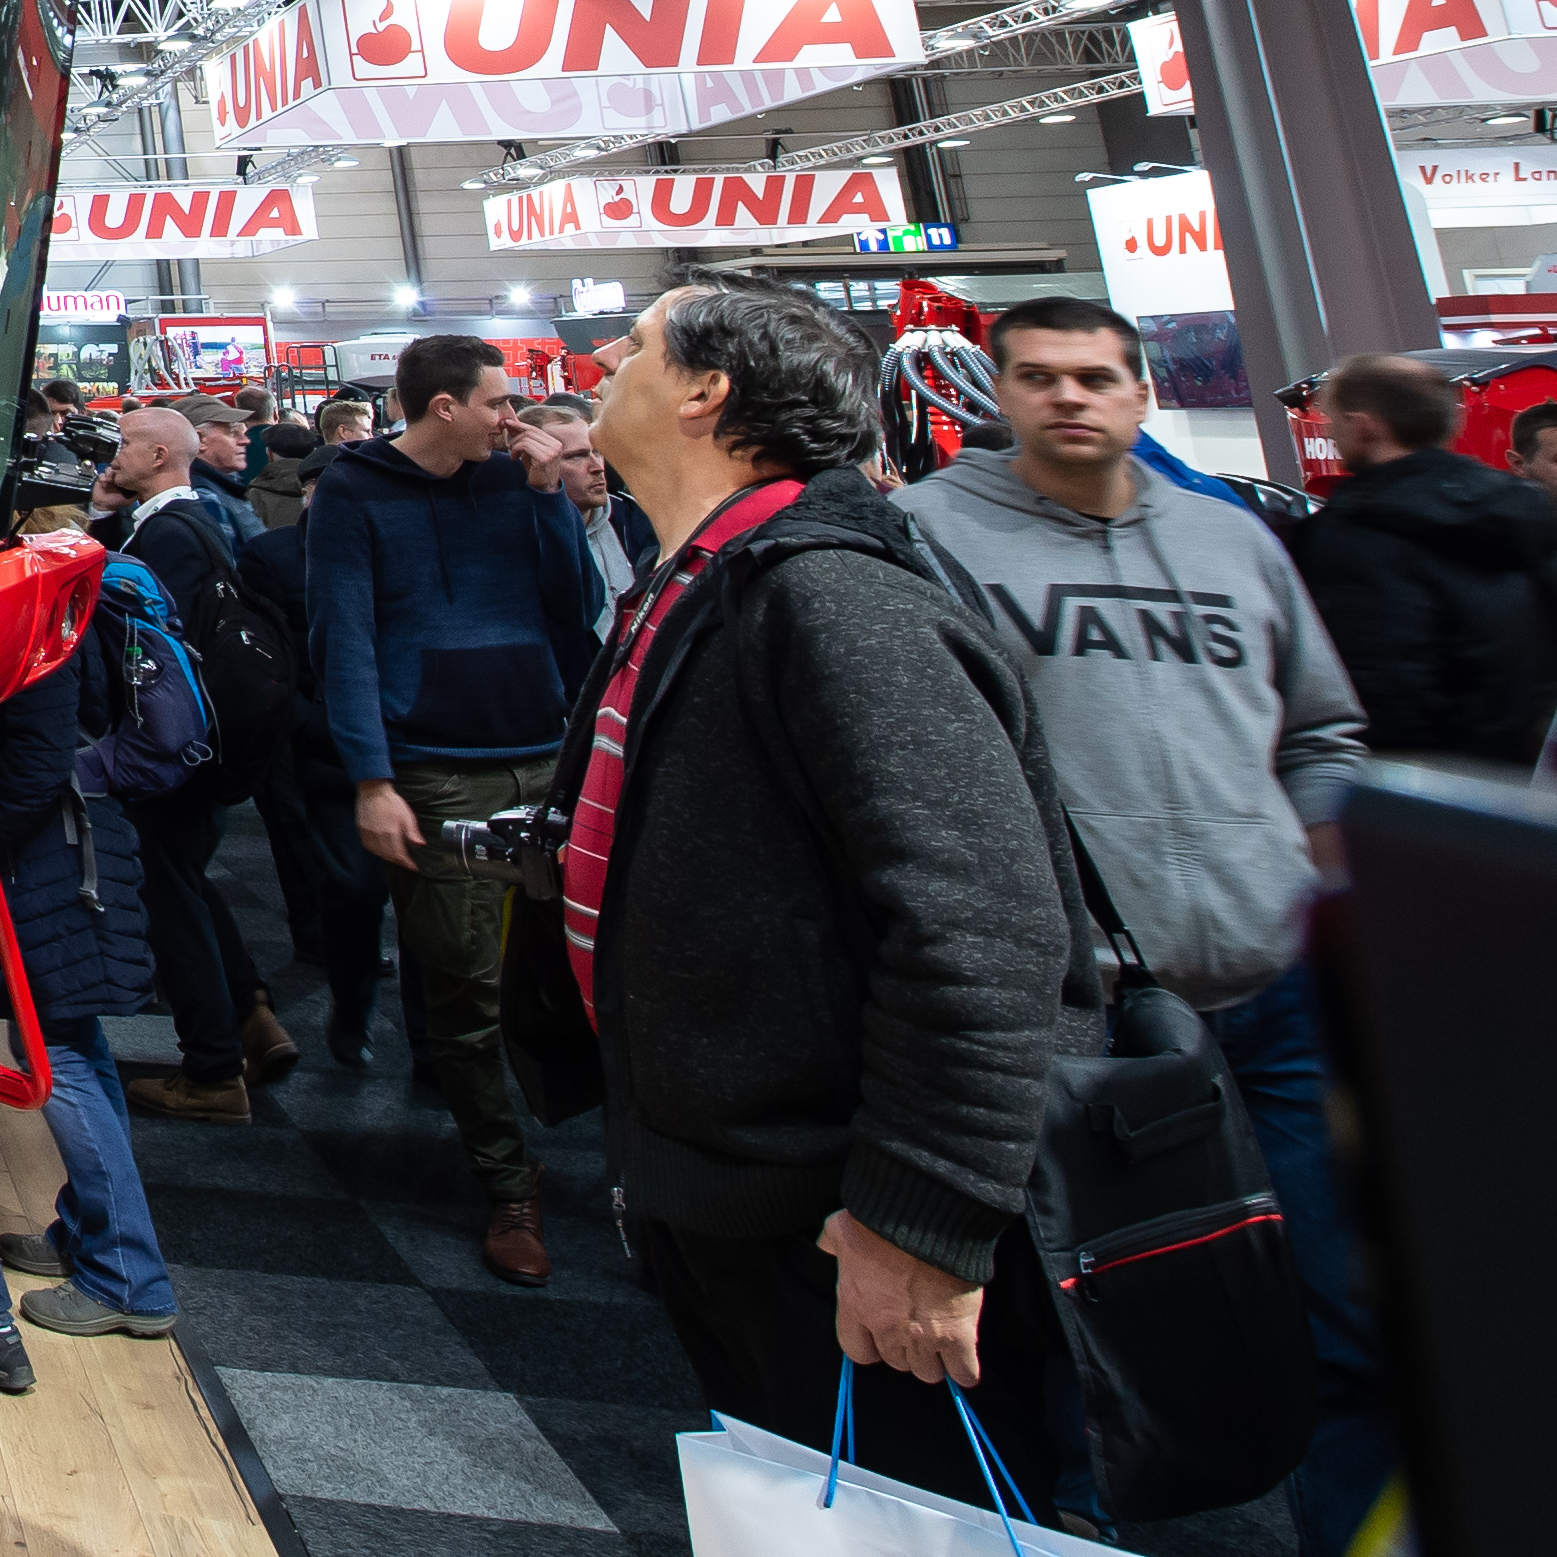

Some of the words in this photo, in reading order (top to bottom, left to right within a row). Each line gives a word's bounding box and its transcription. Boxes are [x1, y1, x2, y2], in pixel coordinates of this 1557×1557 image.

[231, 2, 323, 129] UNIA
[650, 172, 891, 227] UNIA
[1419, 164, 1501, 185] Volker
[88, 189, 303, 240] UNIA
[507, 183, 581, 243] UNIA
[927, 227, 952, 246] 11
[1147, 210, 1223, 256] UNI
[985, 582, 1247, 670] VANS
